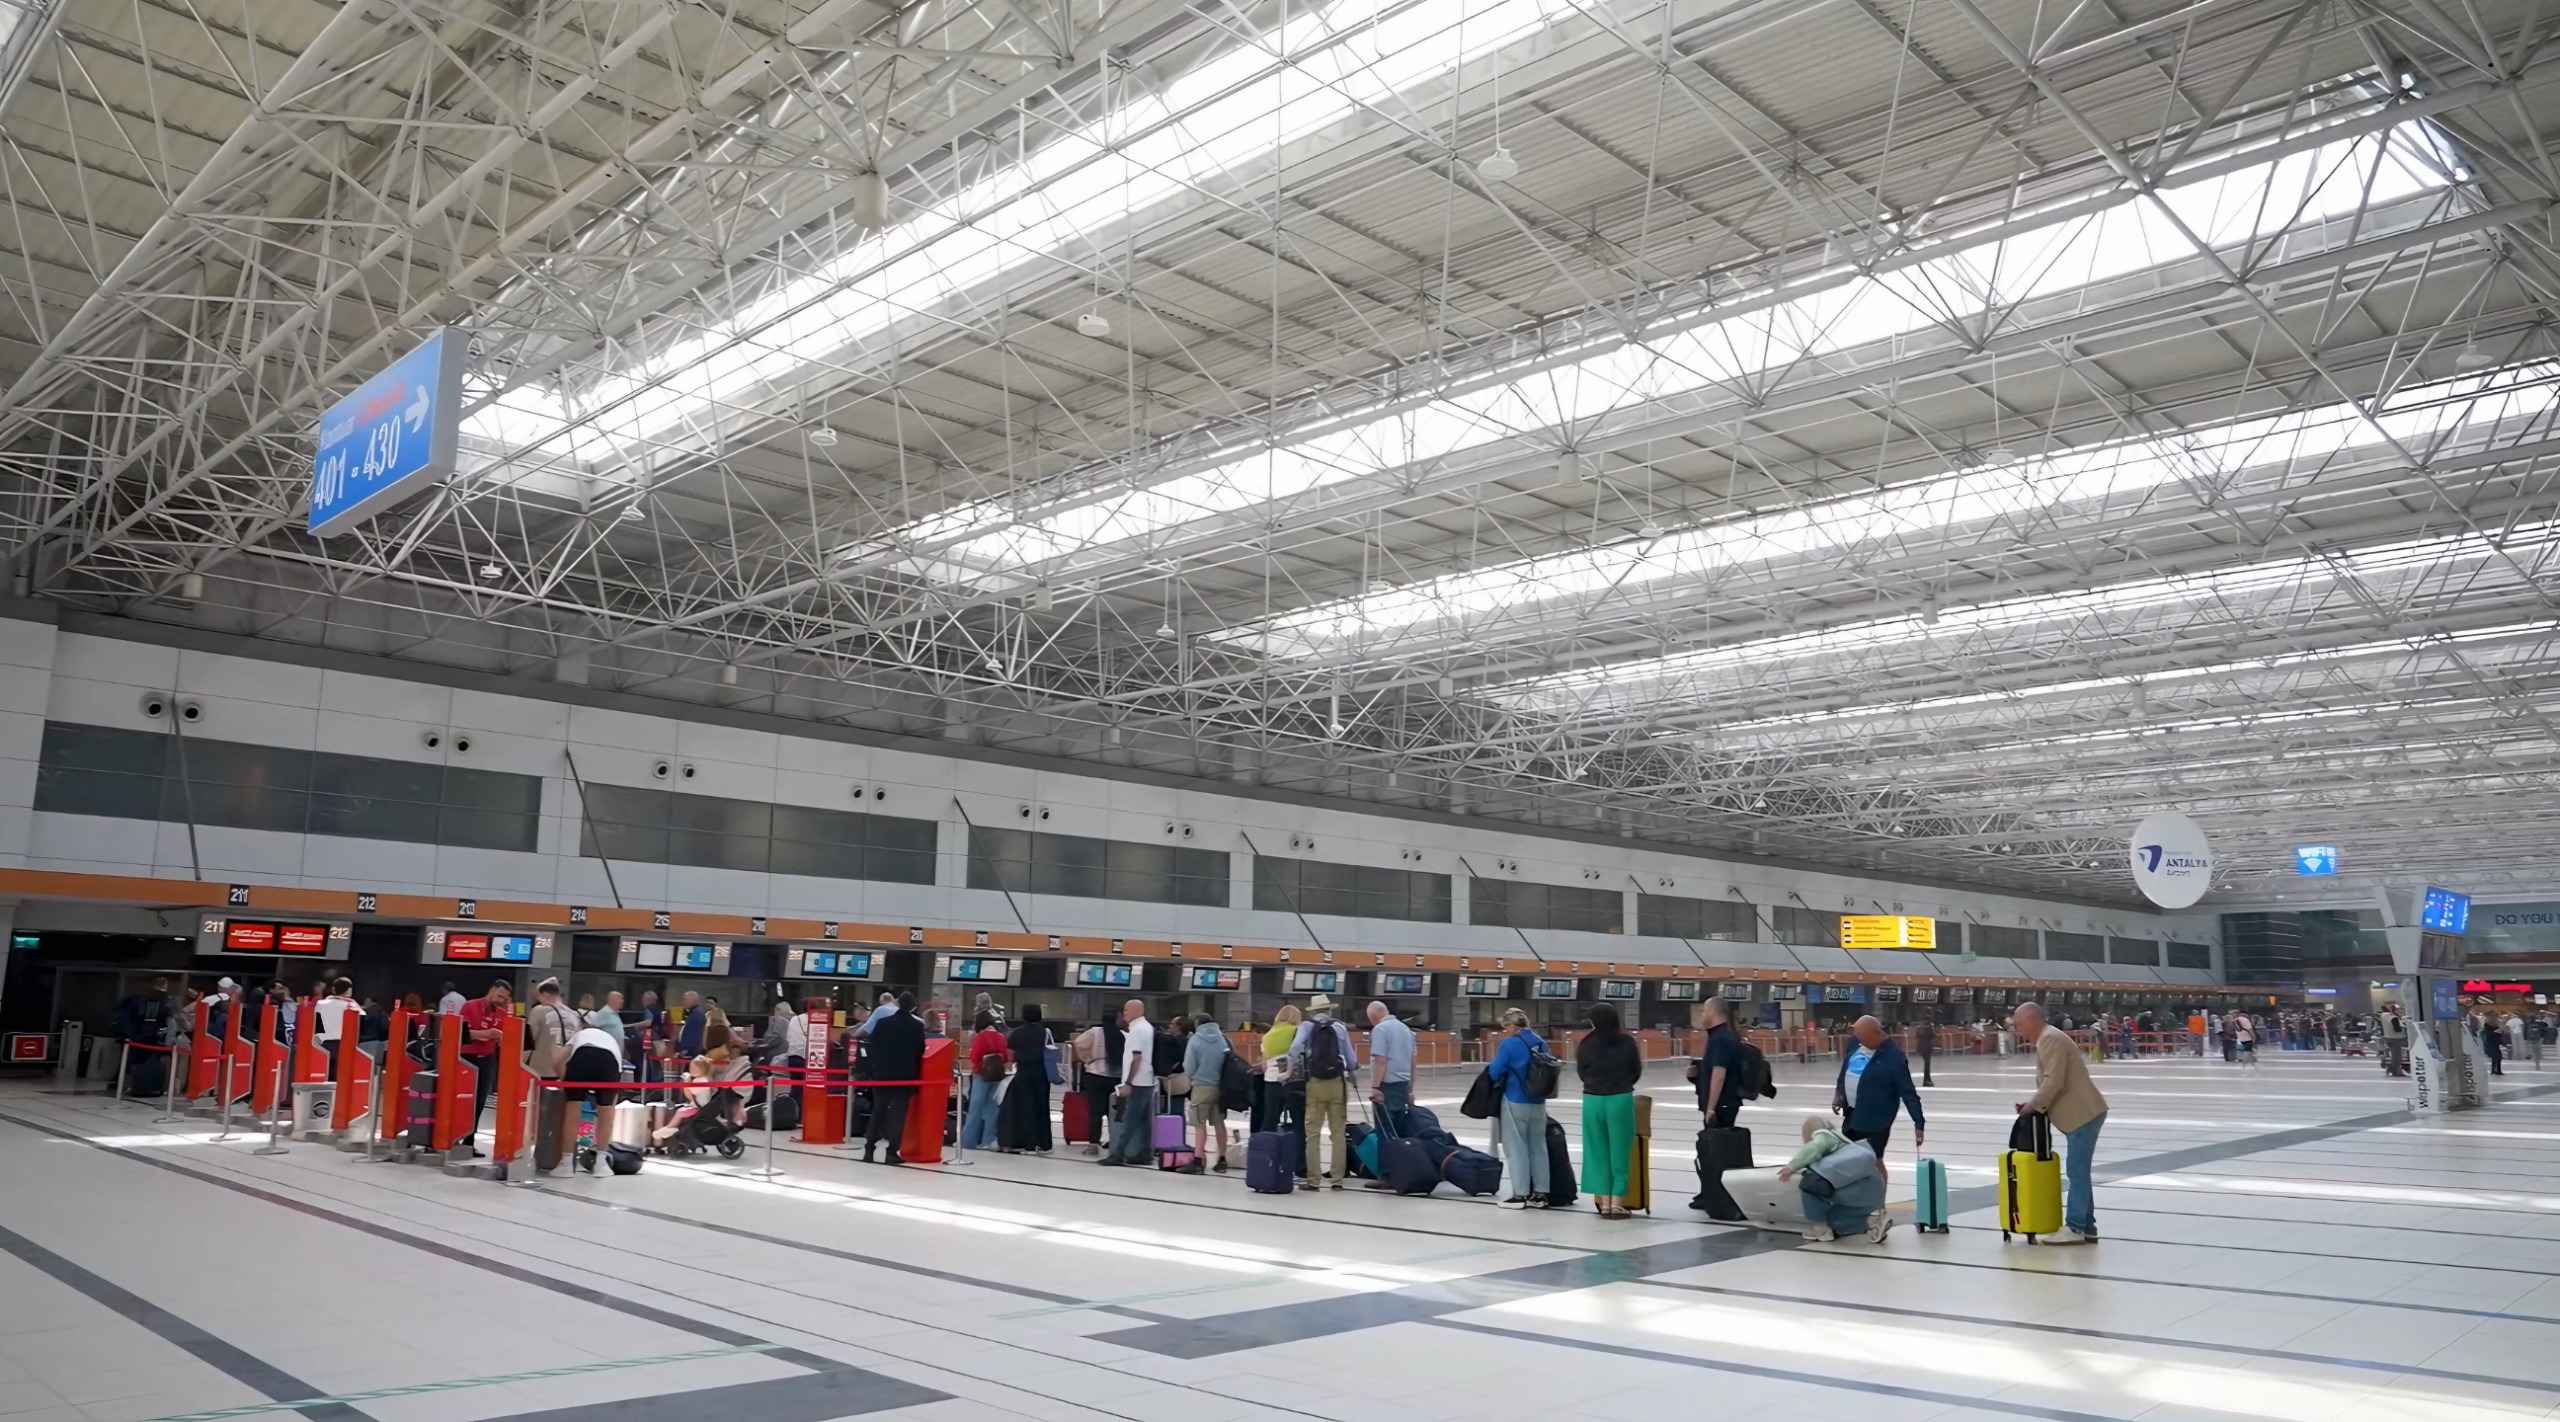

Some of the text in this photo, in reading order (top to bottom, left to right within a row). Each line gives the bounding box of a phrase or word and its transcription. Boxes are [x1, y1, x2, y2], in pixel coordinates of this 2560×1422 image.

[314, 448, 346, 509] 401
[363, 416, 401, 480] 430
[2166, 858, 2208, 868] ANTALYA
[358, 896, 376, 910] 212
[2495, 914, 2518, 925] DO
[204, 920, 224, 933] 211
